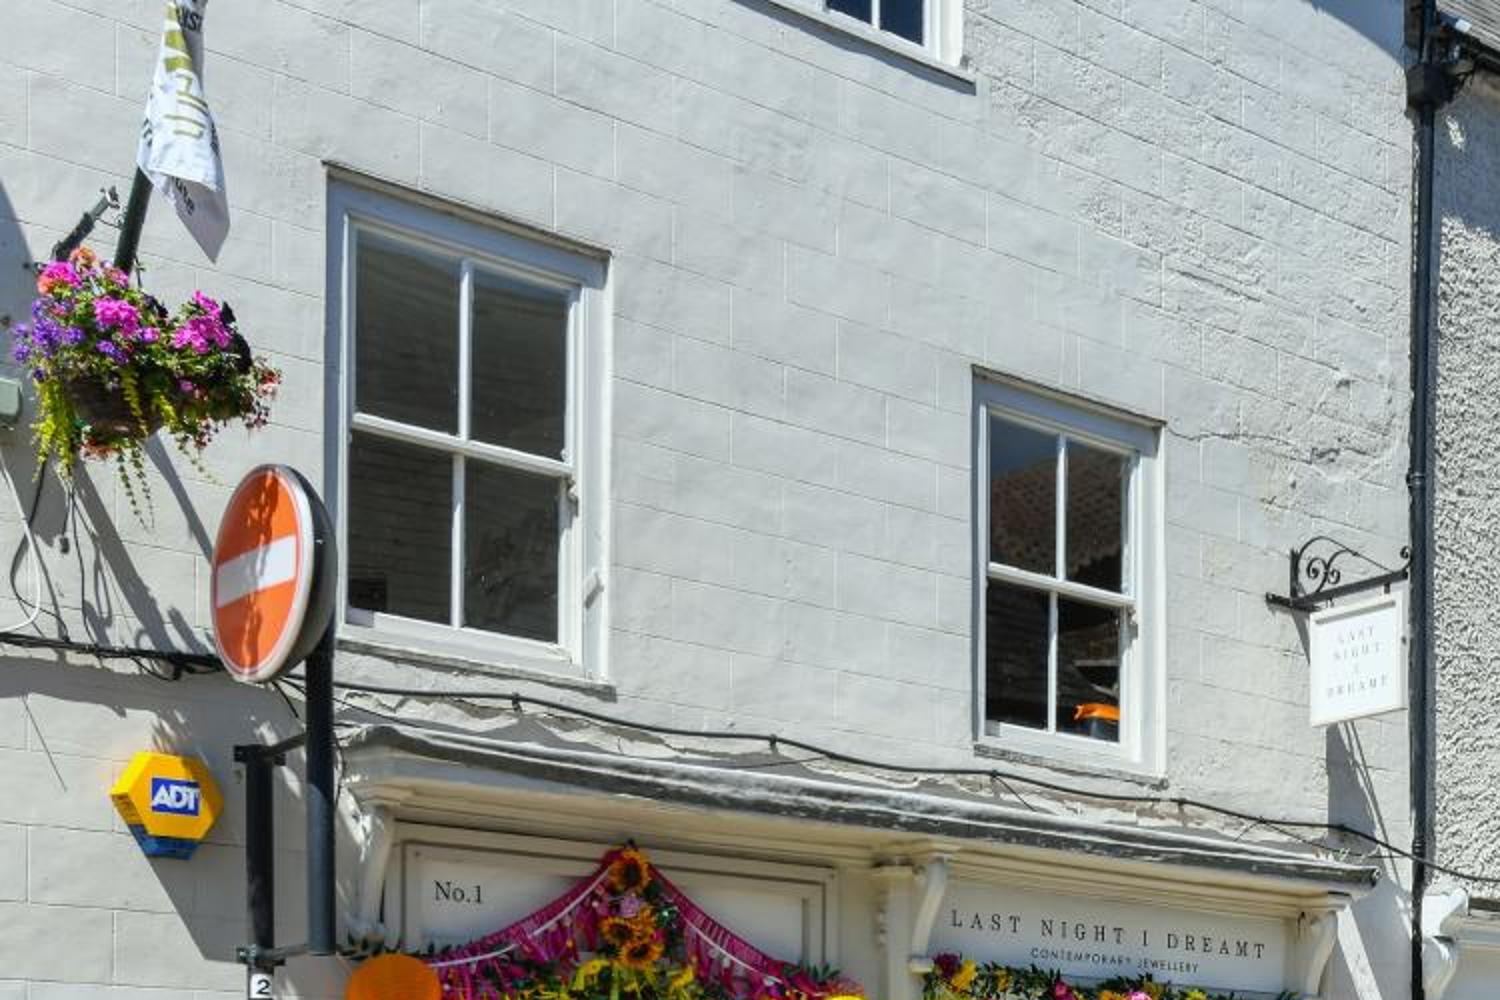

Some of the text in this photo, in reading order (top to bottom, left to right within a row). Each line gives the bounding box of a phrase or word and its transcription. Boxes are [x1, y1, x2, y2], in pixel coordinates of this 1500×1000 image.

[152, 783, 201, 811] ADT
[433, 880, 483, 904] No.1
[952, 909, 1265, 959] LAST NIGHT I DREAMT
[1030, 947, 1199, 974] CONTEMPORARY JEWELLERY
[256, 979, 271, 995] 2
